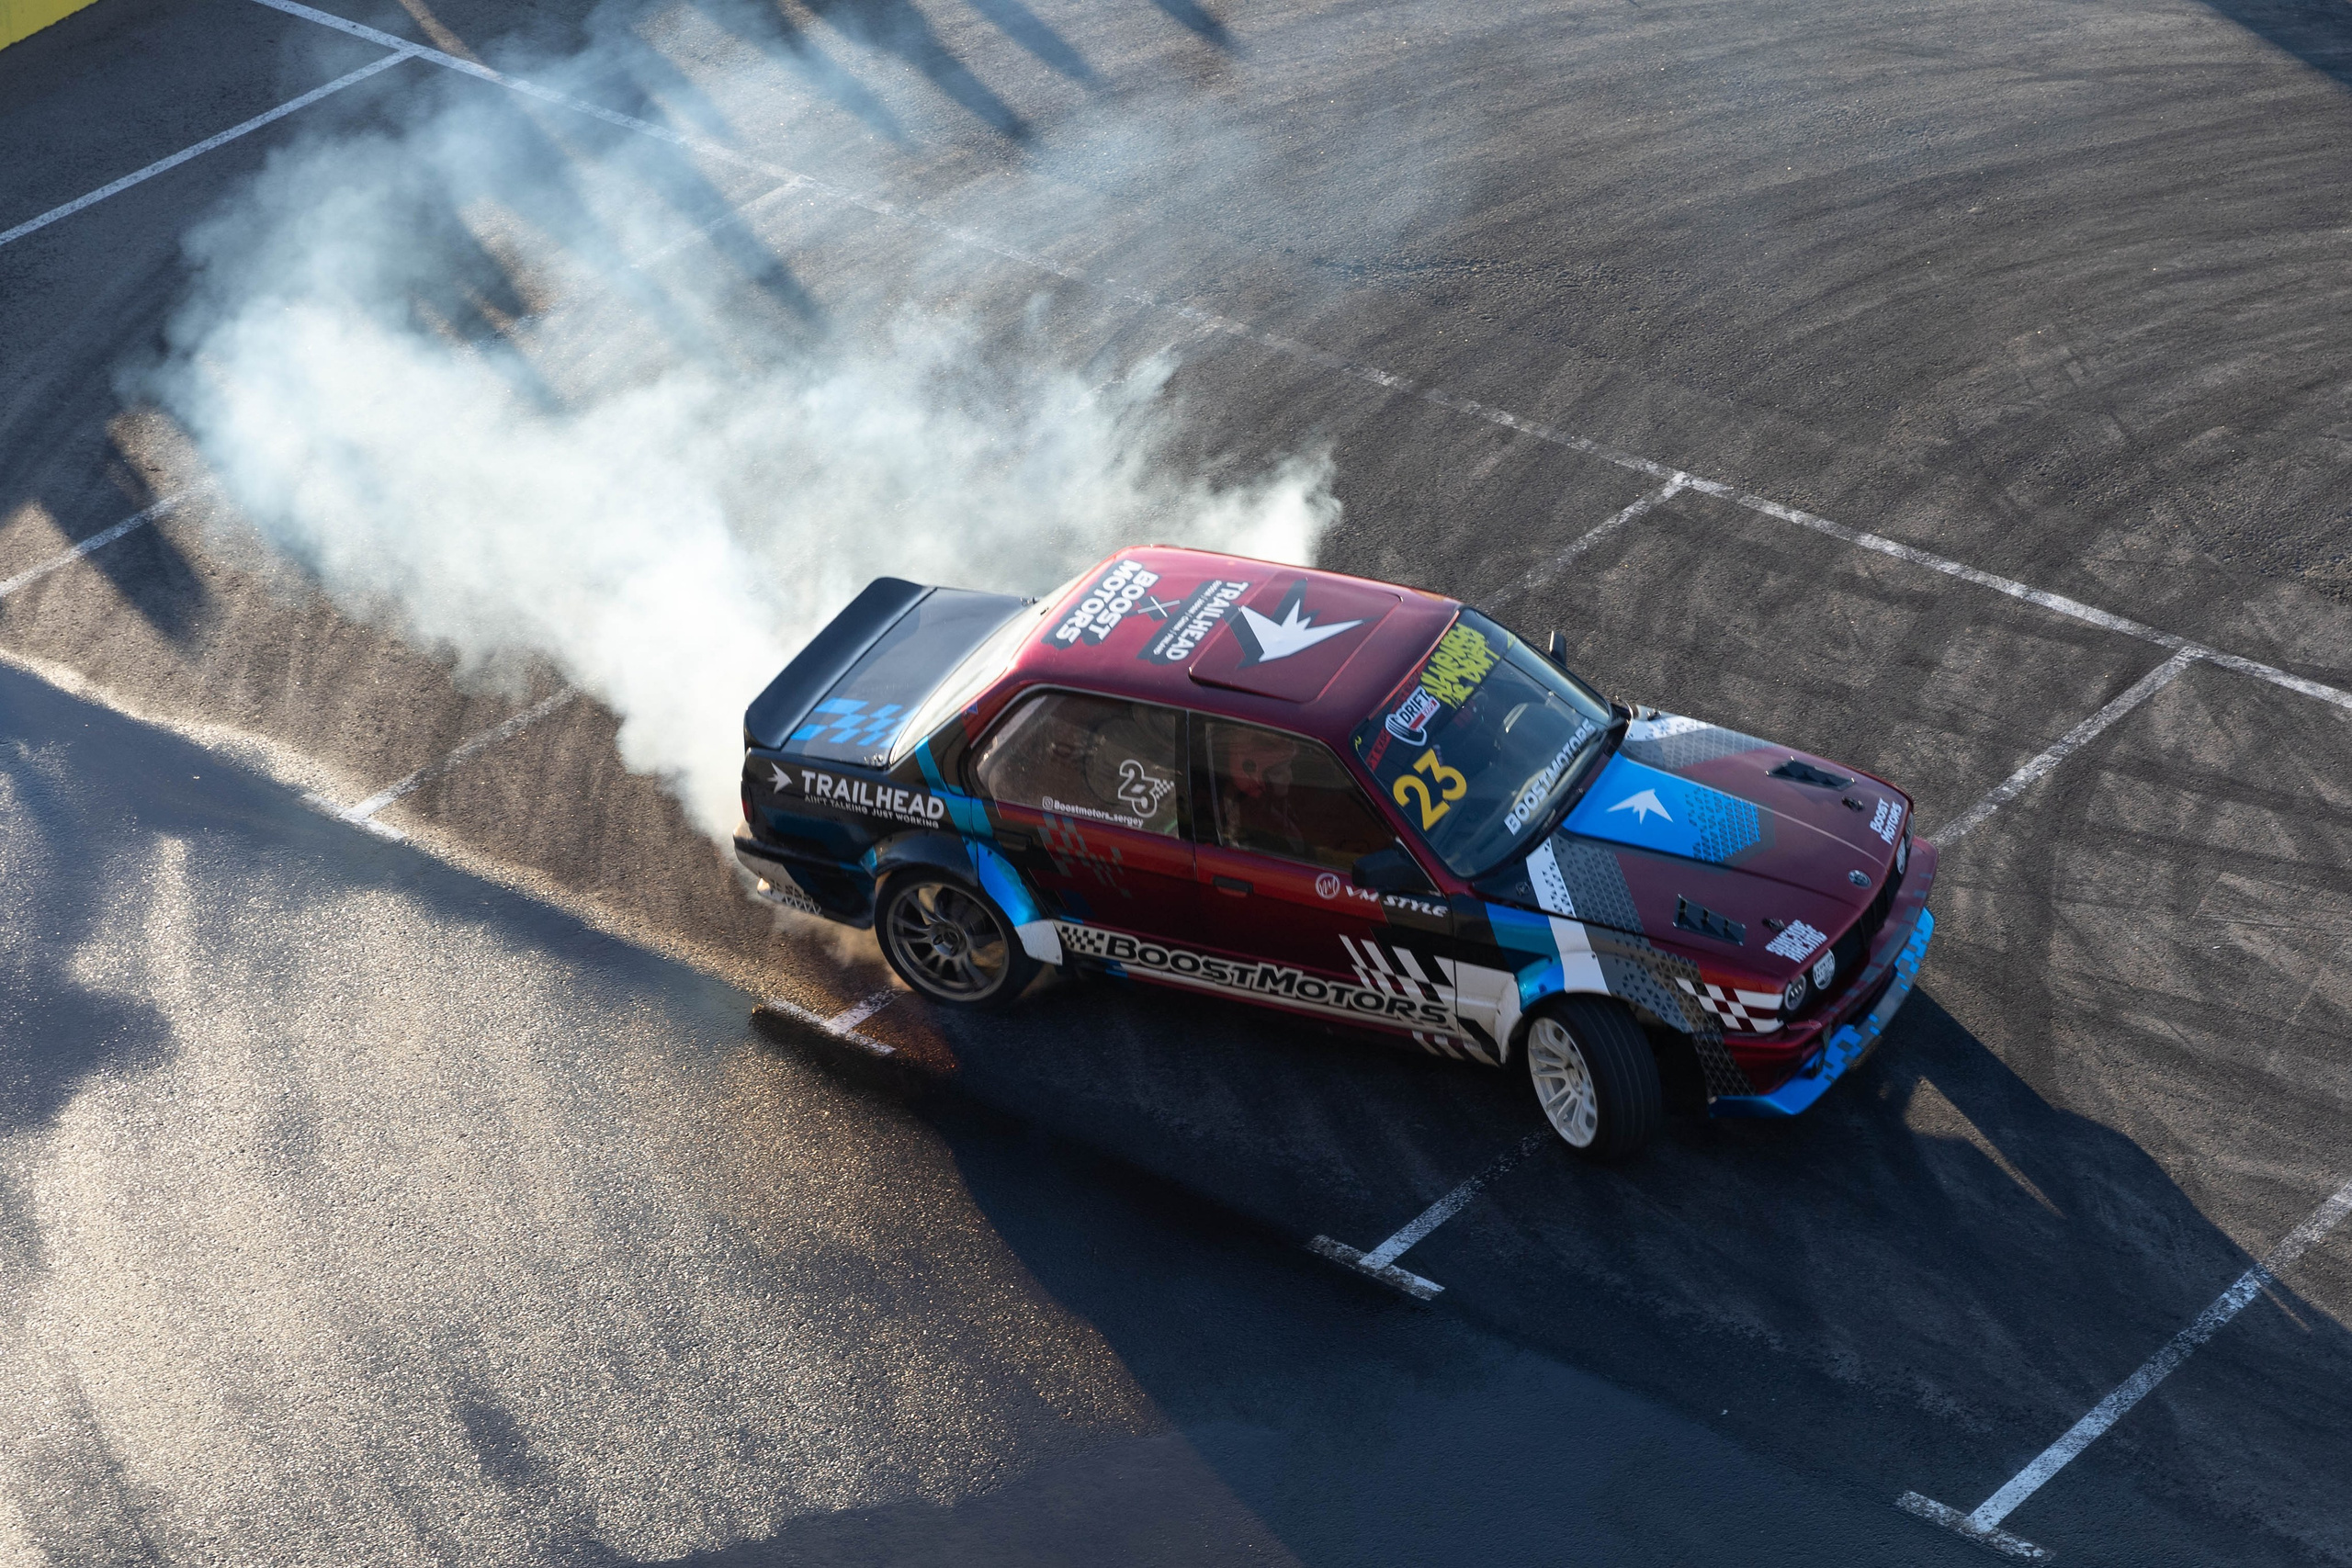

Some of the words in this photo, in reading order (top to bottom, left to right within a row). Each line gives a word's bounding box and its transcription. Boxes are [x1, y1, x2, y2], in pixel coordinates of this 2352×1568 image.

[1057, 559, 1143, 643] MOTORS
[1089, 570, 1159, 641] BOOST
[1166, 581, 1249, 660] TRAILHEAD
[1399, 691, 1430, 723] DRIFT
[801, 770, 944, 820] TRAILHEAD
[1393, 748, 1467, 831] 23
[1503, 717, 1597, 836] BOOSTMOTORS
[829, 797, 868, 815] TALKING
[871, 808, 893, 821] JUST
[895, 812, 940, 829] WORKING
[1869, 796, 1891, 835] BOOST
[1880, 800, 1903, 845] MOTORS
[1384, 895, 1449, 918] STYLE
